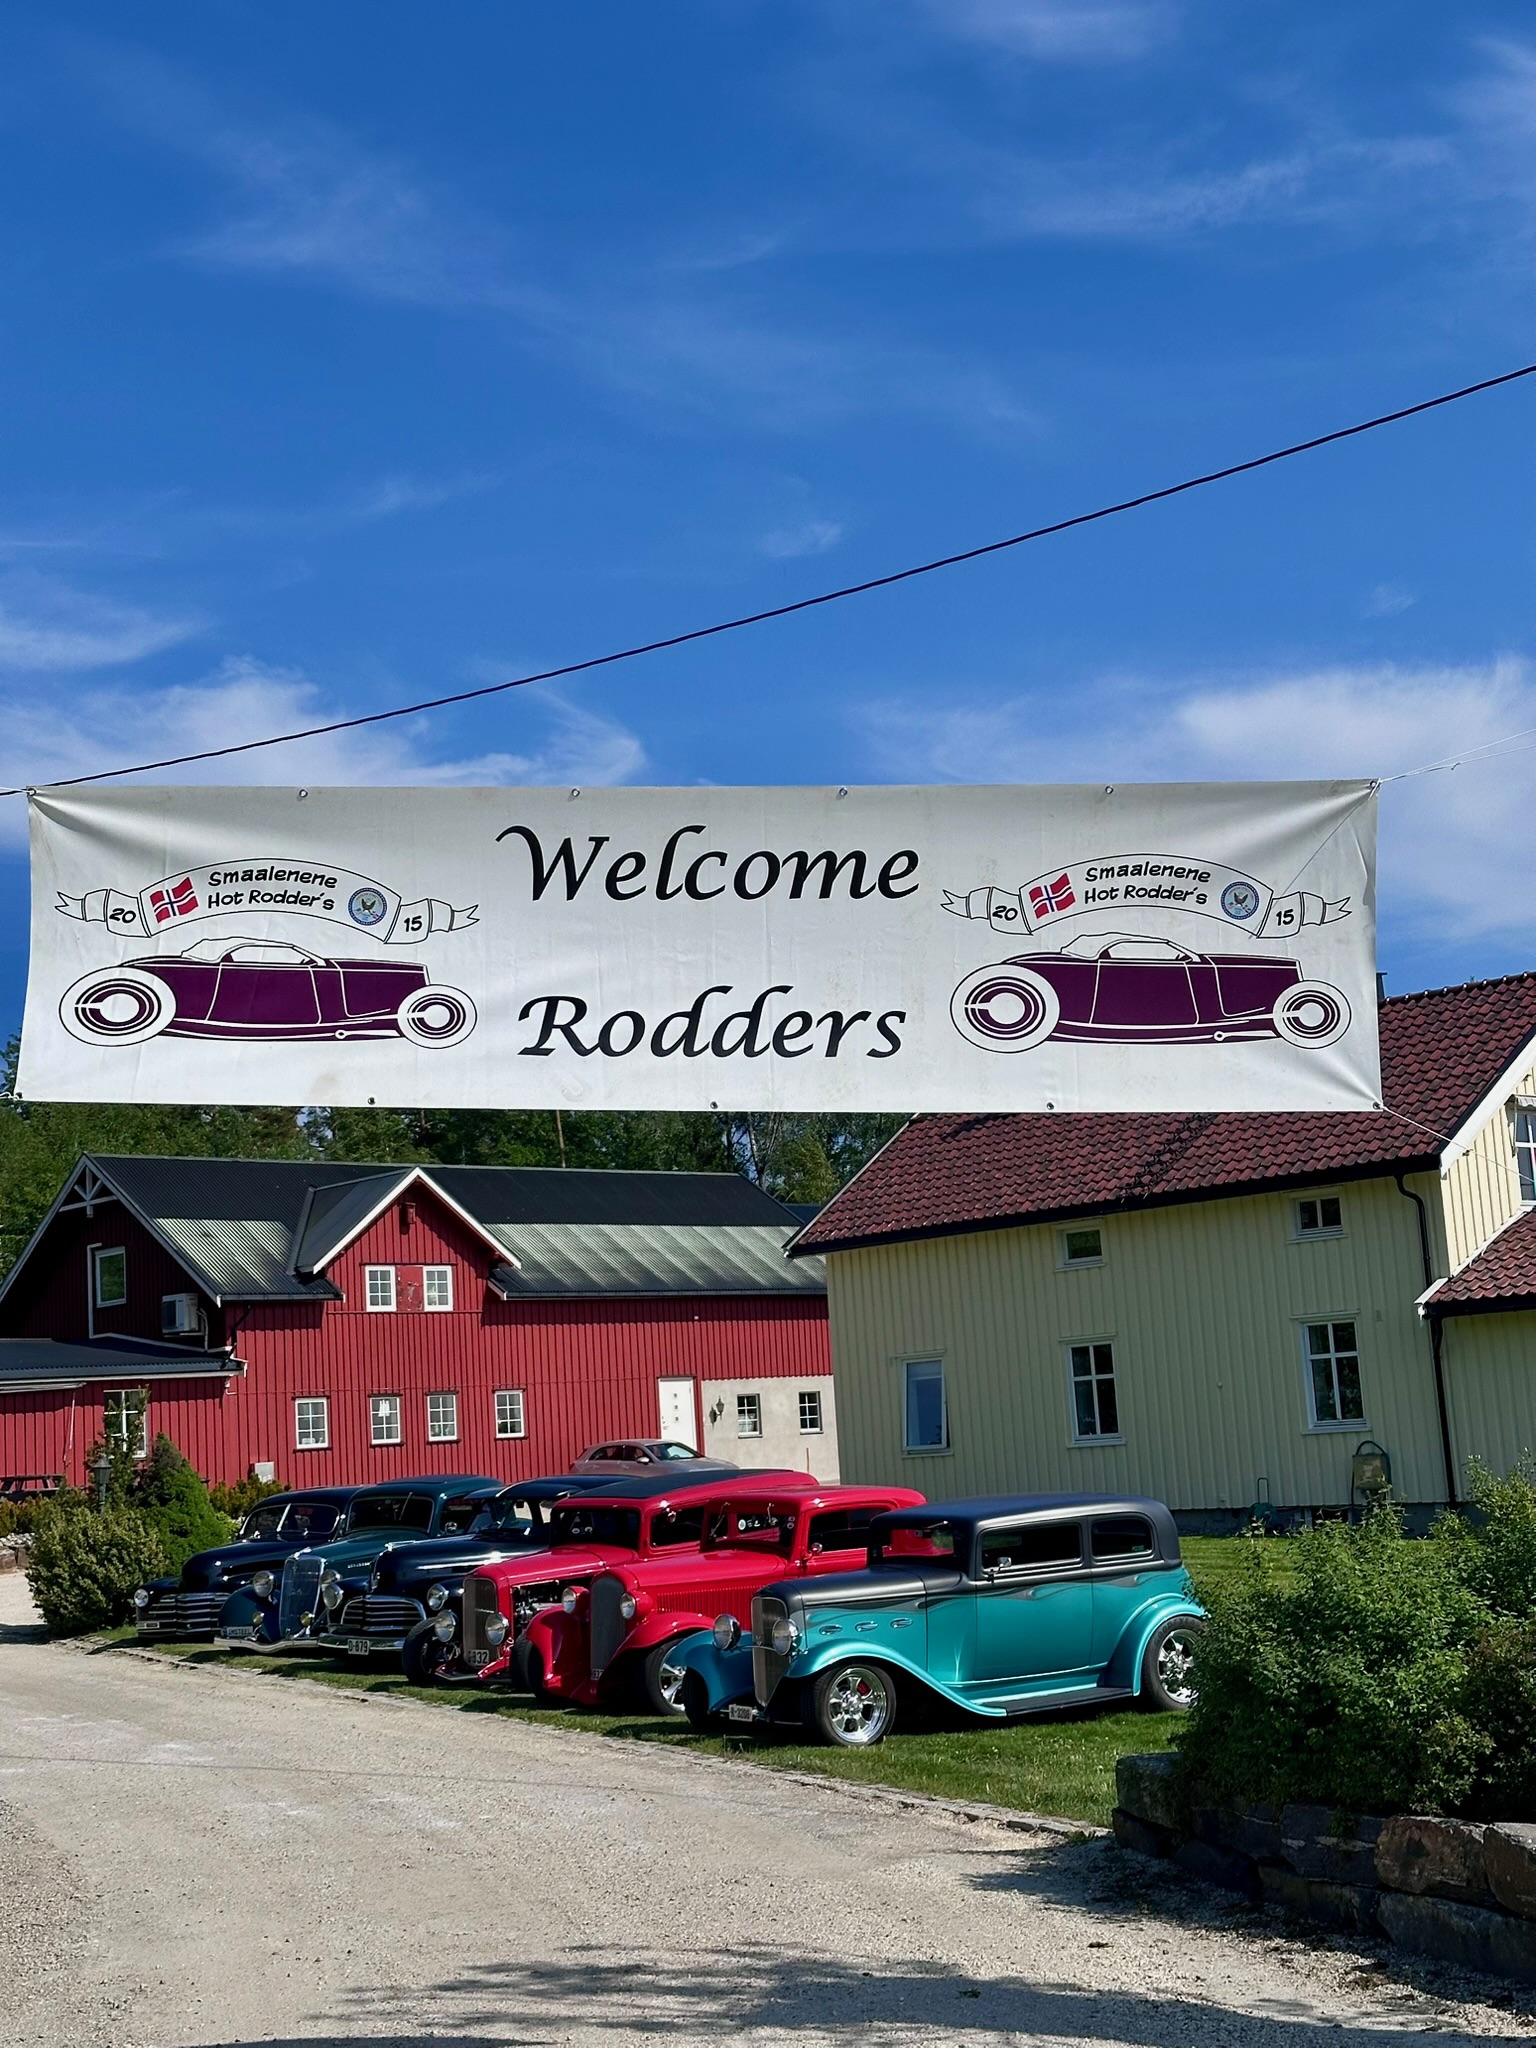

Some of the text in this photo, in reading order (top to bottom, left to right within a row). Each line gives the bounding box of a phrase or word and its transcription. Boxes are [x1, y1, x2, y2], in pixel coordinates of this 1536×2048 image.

[495, 824, 920, 901] Welcome
[208, 865, 338, 889] Smaalenene
[1084, 861, 1211, 883] Smaalenene
[208, 891, 244, 909] Hot
[1084, 886, 1119, 905] Hot
[109, 907, 137, 924] 20
[992, 905, 1018, 921] 20
[1275, 909, 1295, 926] 15
[403, 915, 423, 933] 15
[518, 985, 907, 1059] Rodders
